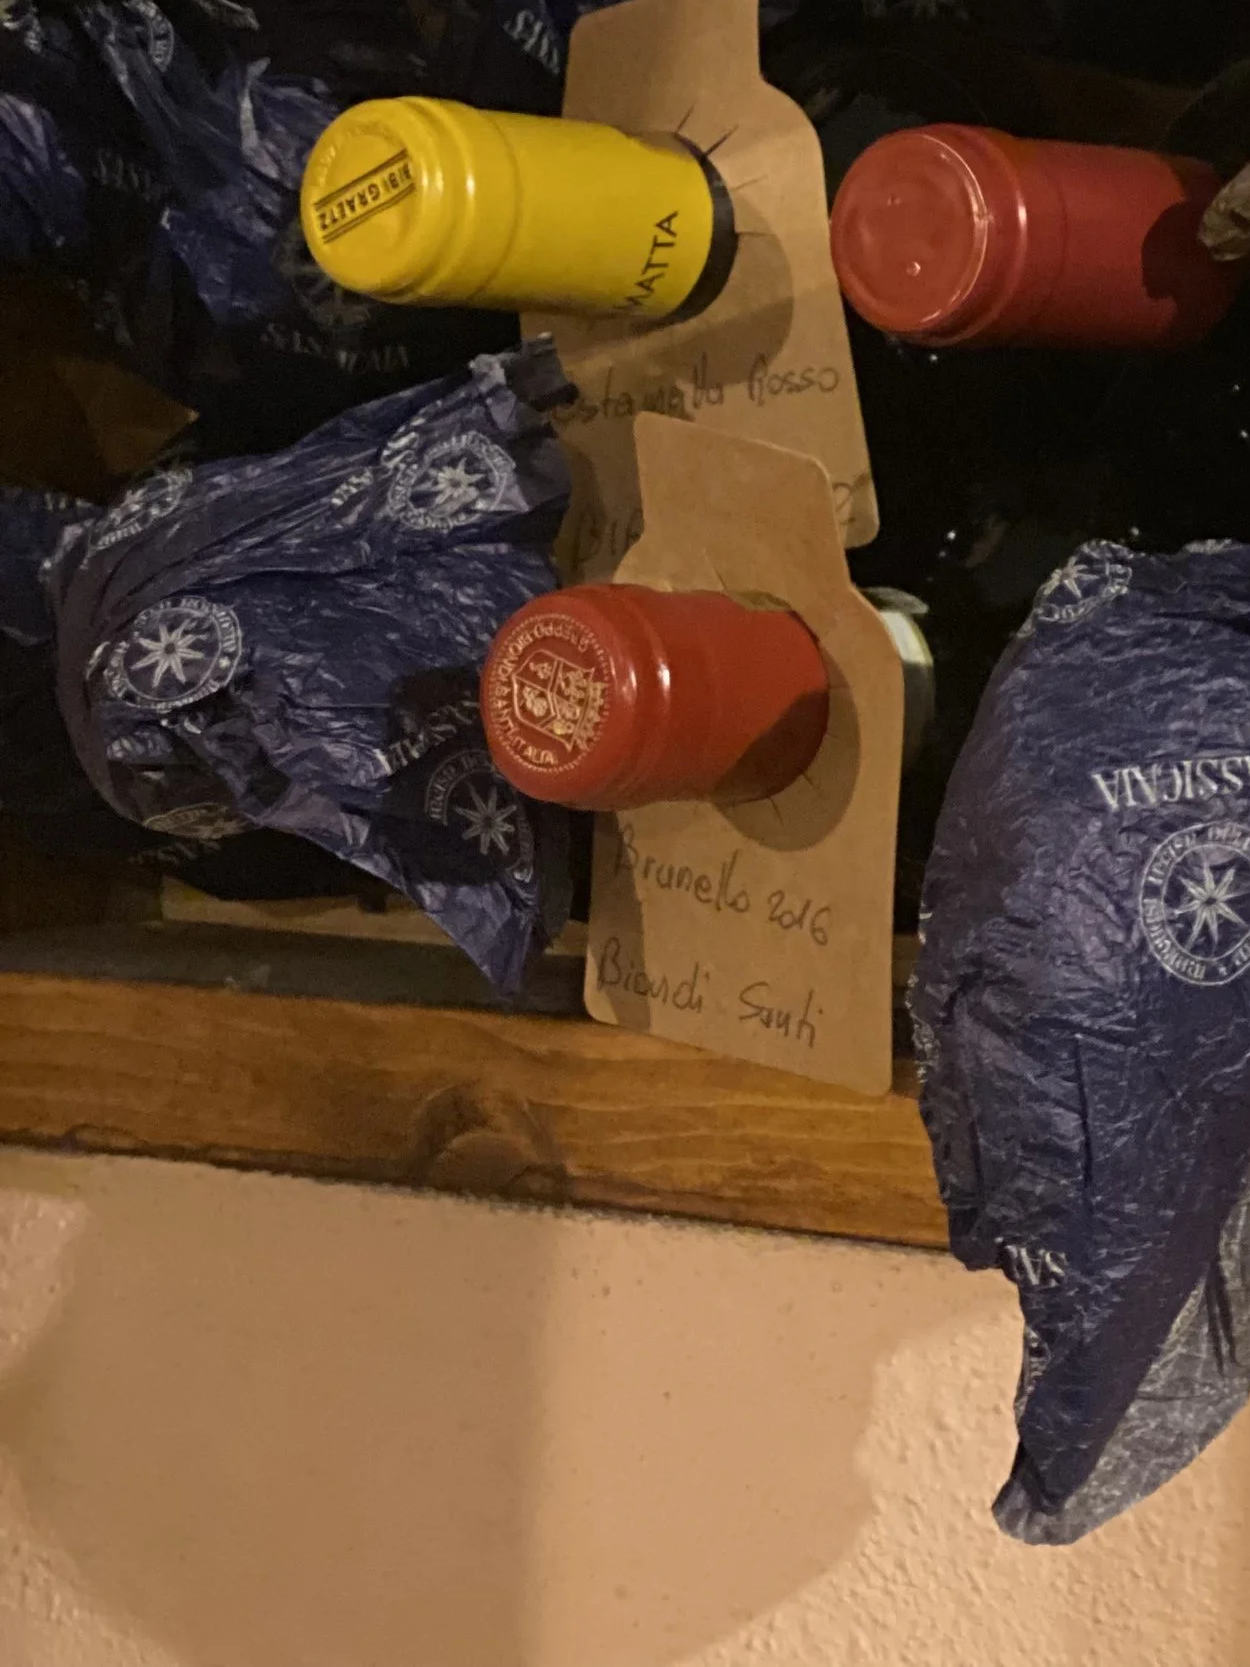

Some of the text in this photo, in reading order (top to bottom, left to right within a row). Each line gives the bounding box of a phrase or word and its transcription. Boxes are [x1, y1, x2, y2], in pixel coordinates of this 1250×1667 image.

[317, 182, 382, 231] GRAETZ
[747, 353, 840, 409] Rosso
[613, 822, 832, 947] Brunello 2016
[599, 936, 711, 1015] Biondi
